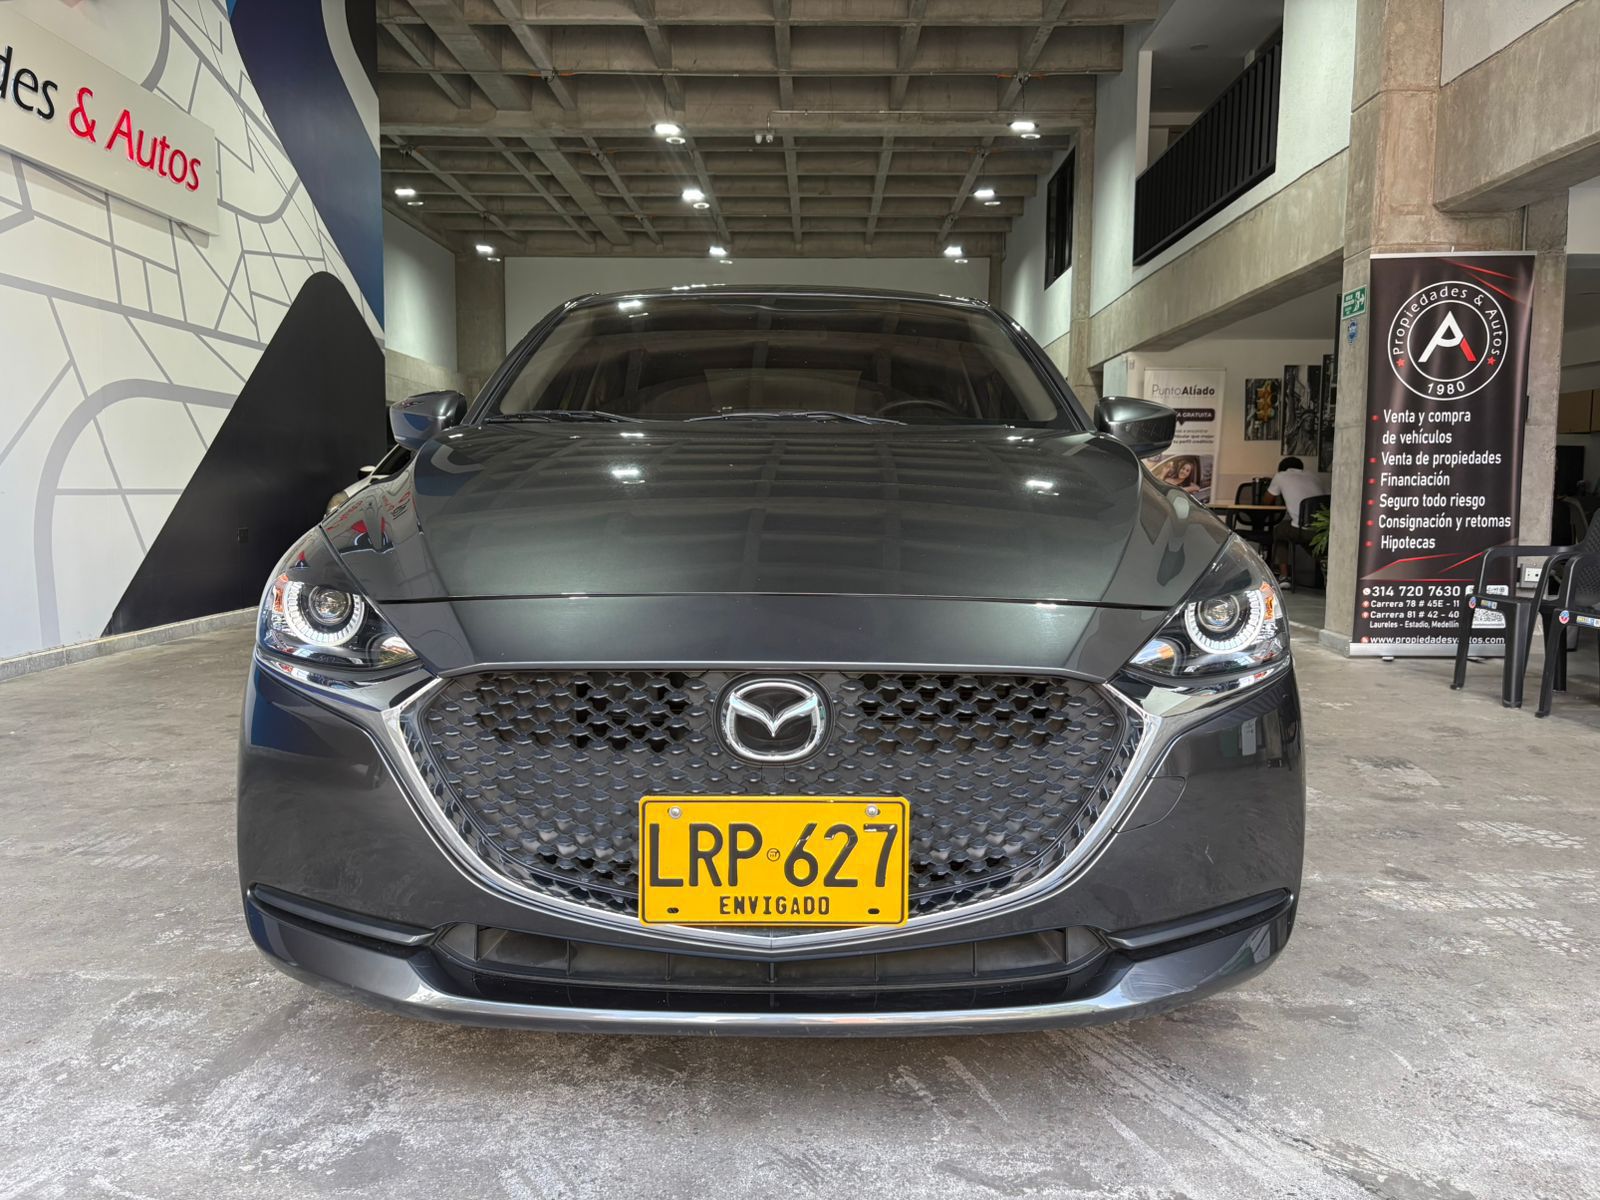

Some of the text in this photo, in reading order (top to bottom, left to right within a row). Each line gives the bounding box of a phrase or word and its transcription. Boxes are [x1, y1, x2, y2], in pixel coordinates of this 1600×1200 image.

[69, 86, 97, 142] &
[105, 109, 201, 191] Autos
[1393, 285, 1468, 355] Propiedades
[1474, 294, 1484, 306] &
[1485, 308, 1502, 355] Autos
[1427, 381, 1466, 395] 1980
[1383, 409, 1471, 426] Venta y compra
[1382, 428, 1452, 445] de vehículos
[1381, 450, 1502, 468] Venta de propiedades
[1380, 470, 1450, 486] Financiación
[1379, 493, 1486, 510] Seguro todo riesgo
[1378, 513, 1512, 531] Consignación y retomas
[1380, 535, 1436, 552] Hipotecas
[1371, 586, 1461, 597] 314 720 7630
[1370, 600, 1404, 608] Carrera
[1406, 600, 1416, 608] 78
[1418, 600, 1424, 608] #
[1427, 600, 1443, 608] 45E
[1453, 600, 1460, 608] 11
[1370, 611, 1404, 619] Carrera
[1406, 611, 1416, 619] 81
[1418, 611, 1425, 619] #
[1427, 611, 1438, 619] 42
[1448, 611, 1460, 619] 40
[1404, 621, 1431, 629] Estadio,
[1431, 620, 1460, 628] Medellín
[649, 822, 898, 888] LRP 627
[719, 895, 830, 915] ENVIGADO
